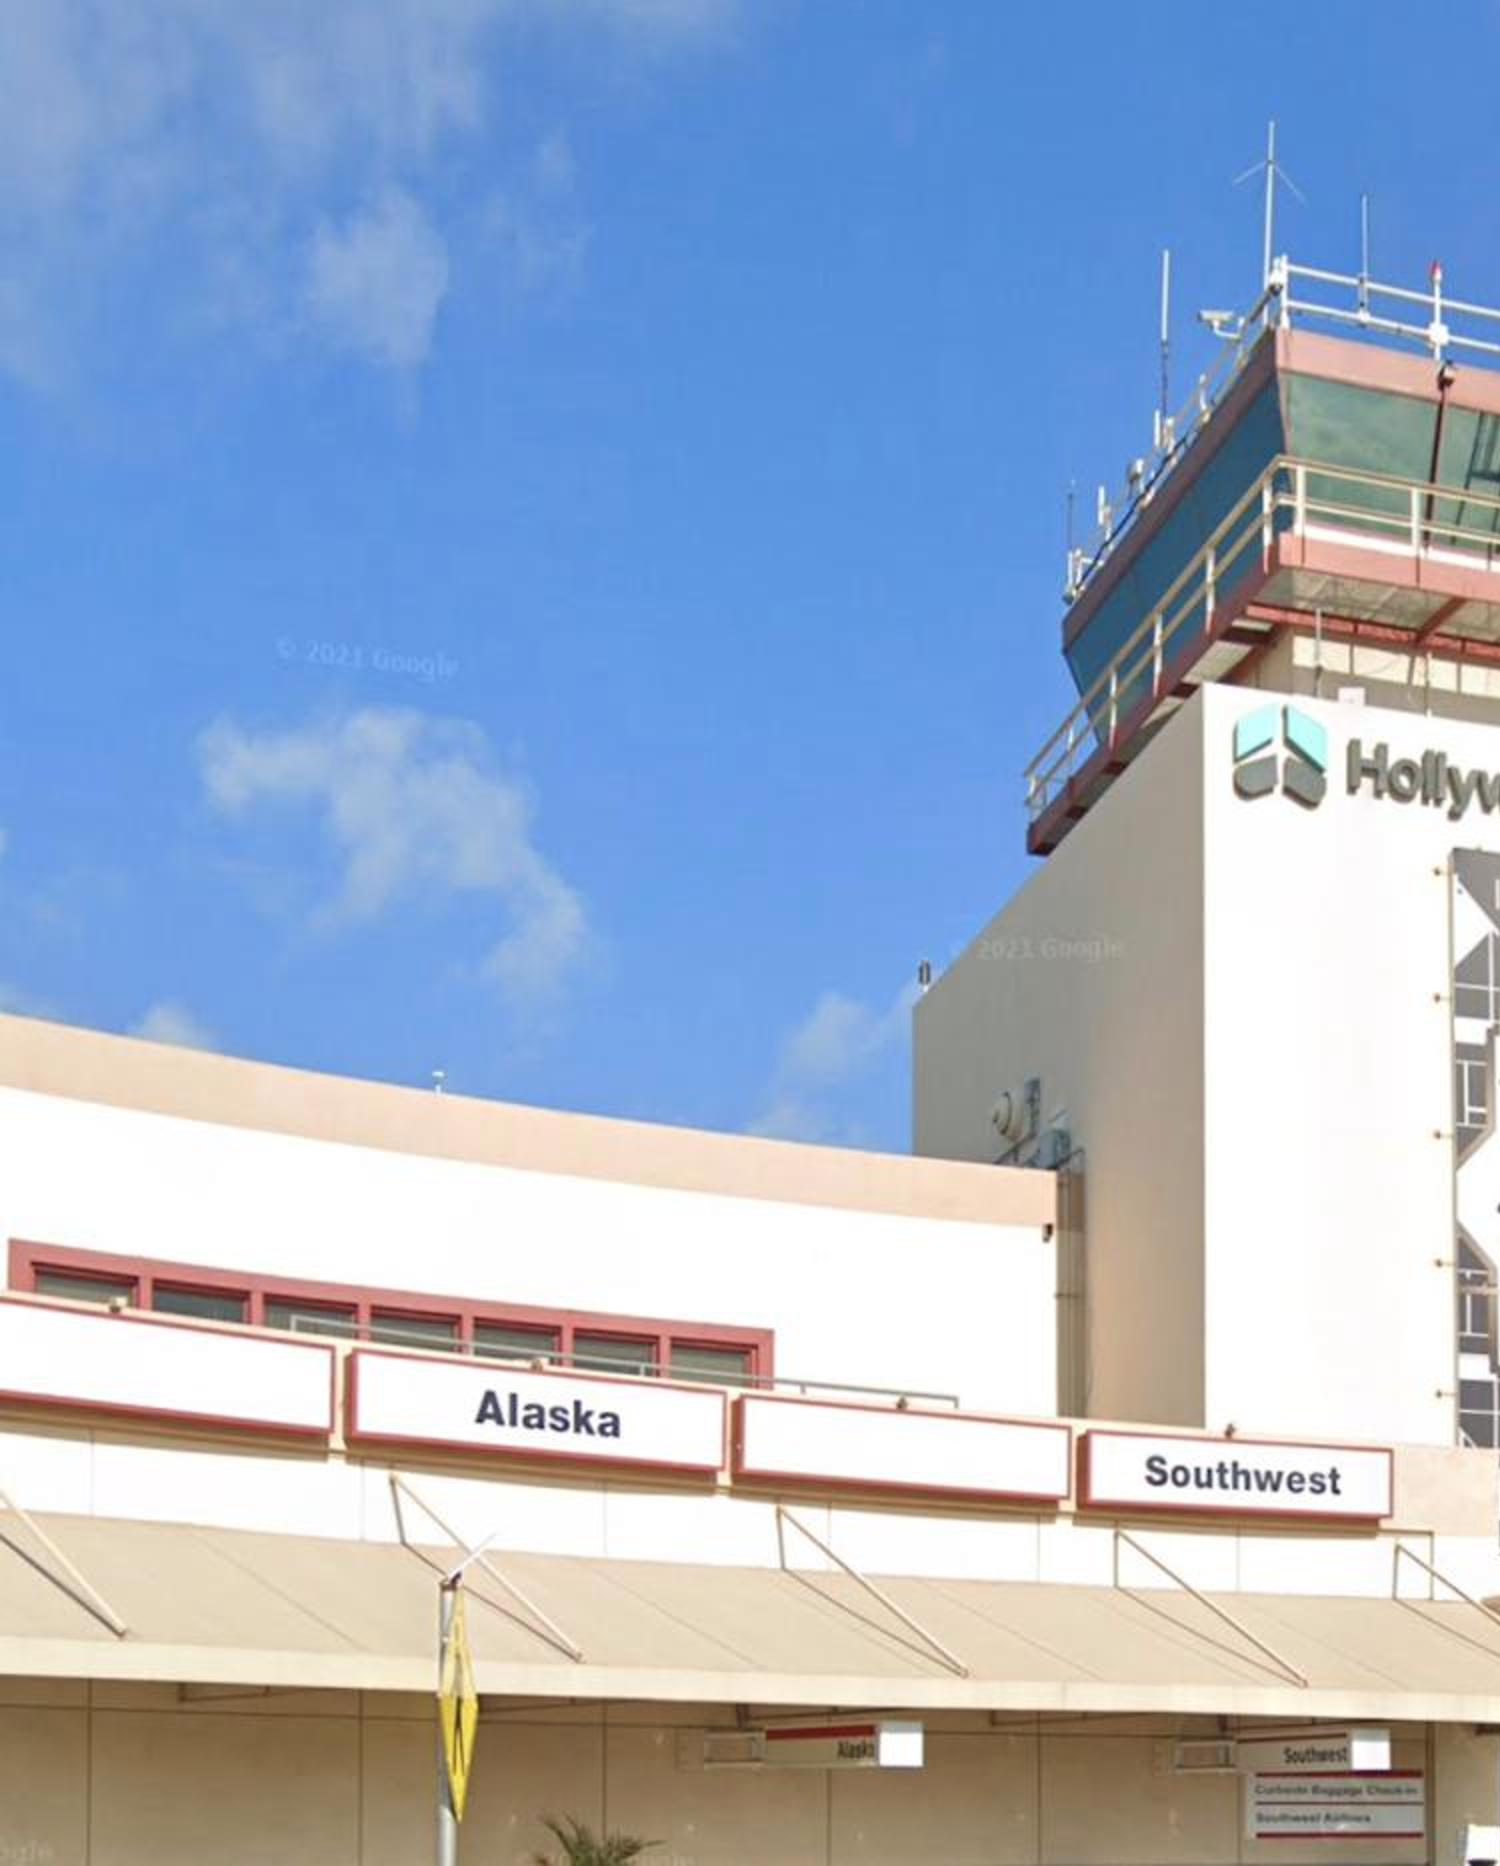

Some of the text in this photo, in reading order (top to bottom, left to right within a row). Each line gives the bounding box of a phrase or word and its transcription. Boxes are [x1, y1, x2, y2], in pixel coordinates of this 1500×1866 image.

[474, 1389, 622, 1439] Alaska
[1145, 1455, 1342, 1496] Southwest
[837, 1740, 876, 1760] Alaska
[1283, 1746, 1348, 1765] Southwest
